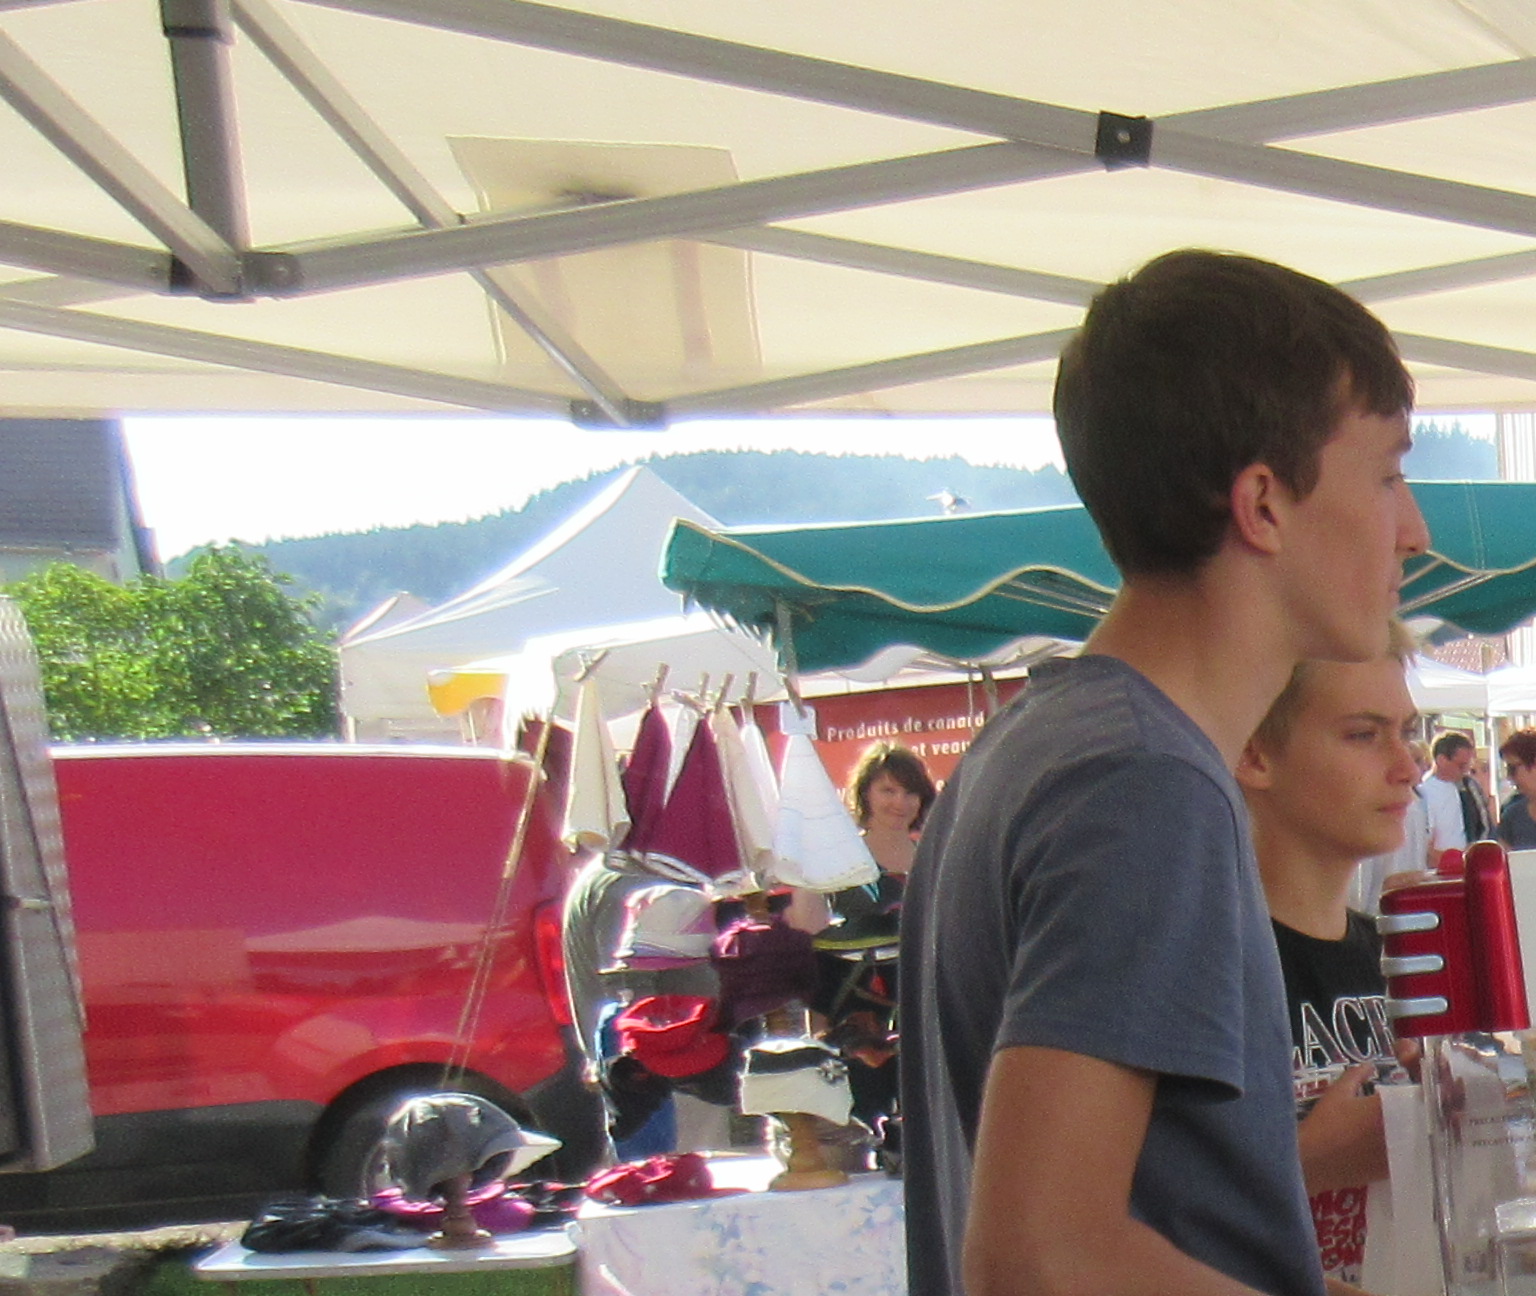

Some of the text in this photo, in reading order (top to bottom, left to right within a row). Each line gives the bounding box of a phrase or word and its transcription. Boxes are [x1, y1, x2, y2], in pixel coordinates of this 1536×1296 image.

[827, 710, 986, 743] Produits de canard
